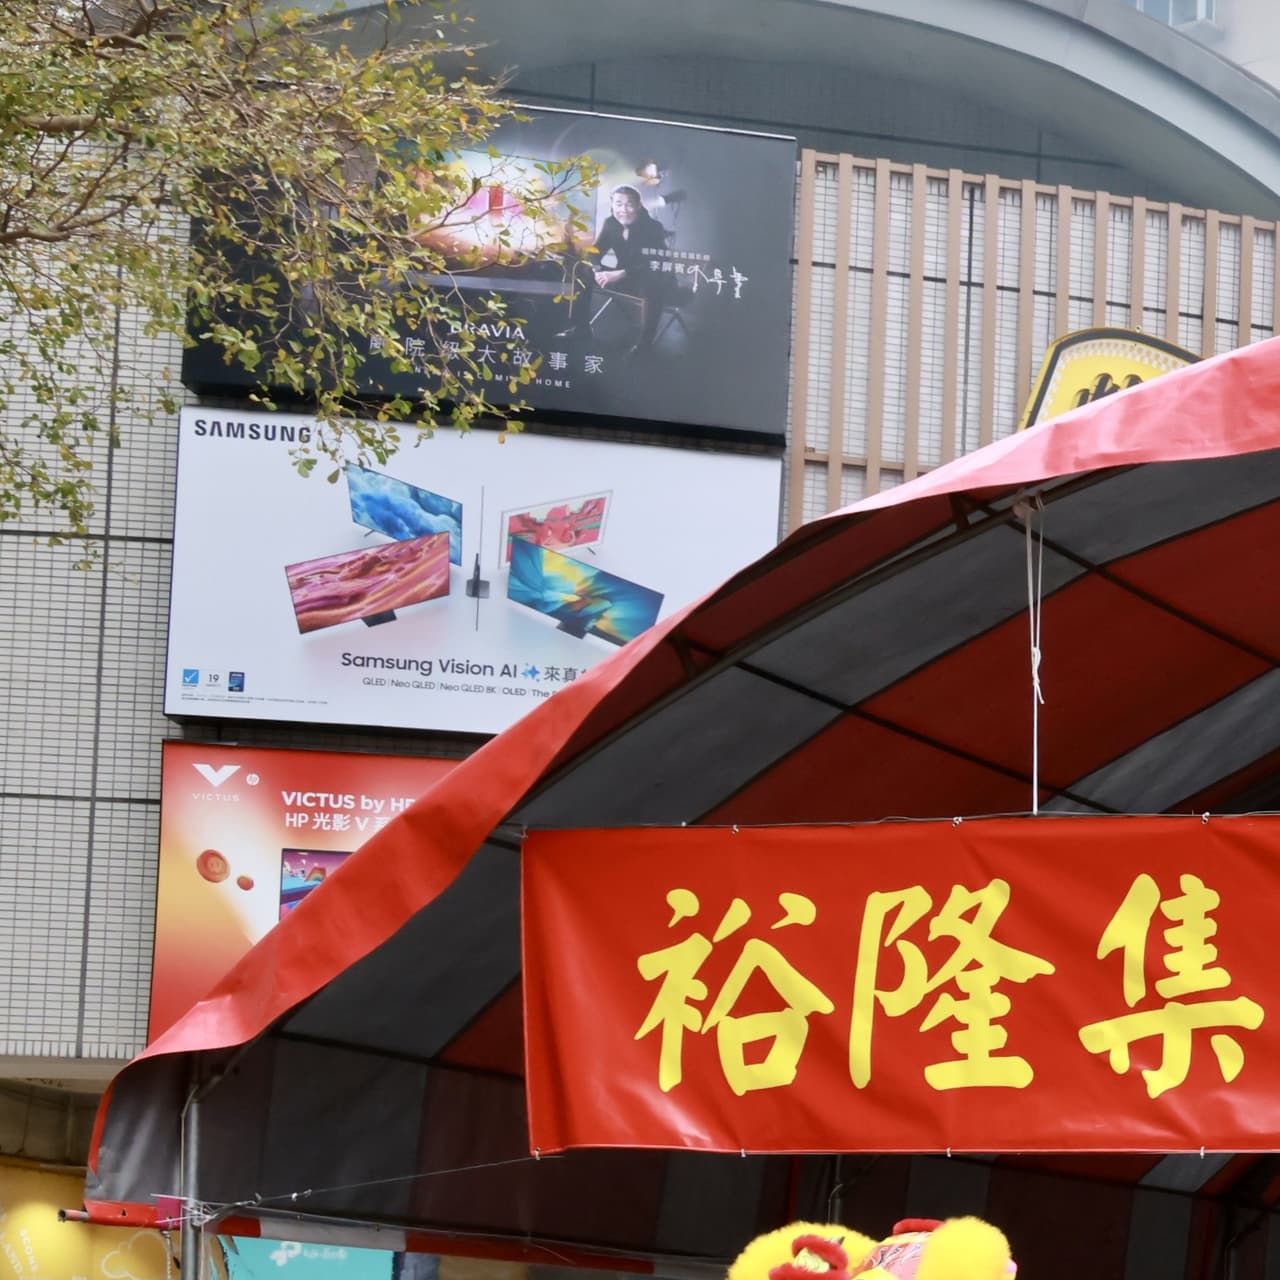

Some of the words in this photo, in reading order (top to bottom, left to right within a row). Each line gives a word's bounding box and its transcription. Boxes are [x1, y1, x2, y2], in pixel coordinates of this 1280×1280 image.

[535, 377, 571, 389] HOME
[194, 418, 311, 444] SAMSUNG
[341, 652, 433, 676] Samsung
[438, 659, 494, 677] Vision
[499, 663, 518, 678] AI
[544, 666, 587, 681] 來真
[362, 677, 387, 687] QLED
[391, 678, 411, 688] Neo
[413, 680, 436, 690] QLED
[440, 682, 460, 692] Neo
[462, 683, 485, 693] QLED
[502, 686, 527, 697] OLED
[532, 688, 550, 698] The
[193, 792, 241, 801] VICTUS
[281, 791, 355, 809] VICTUS
[361, 795, 385, 812] by
[285, 813, 308, 828] HP
[312, 813, 350, 831] 光影
[355, 817, 368, 831] V
